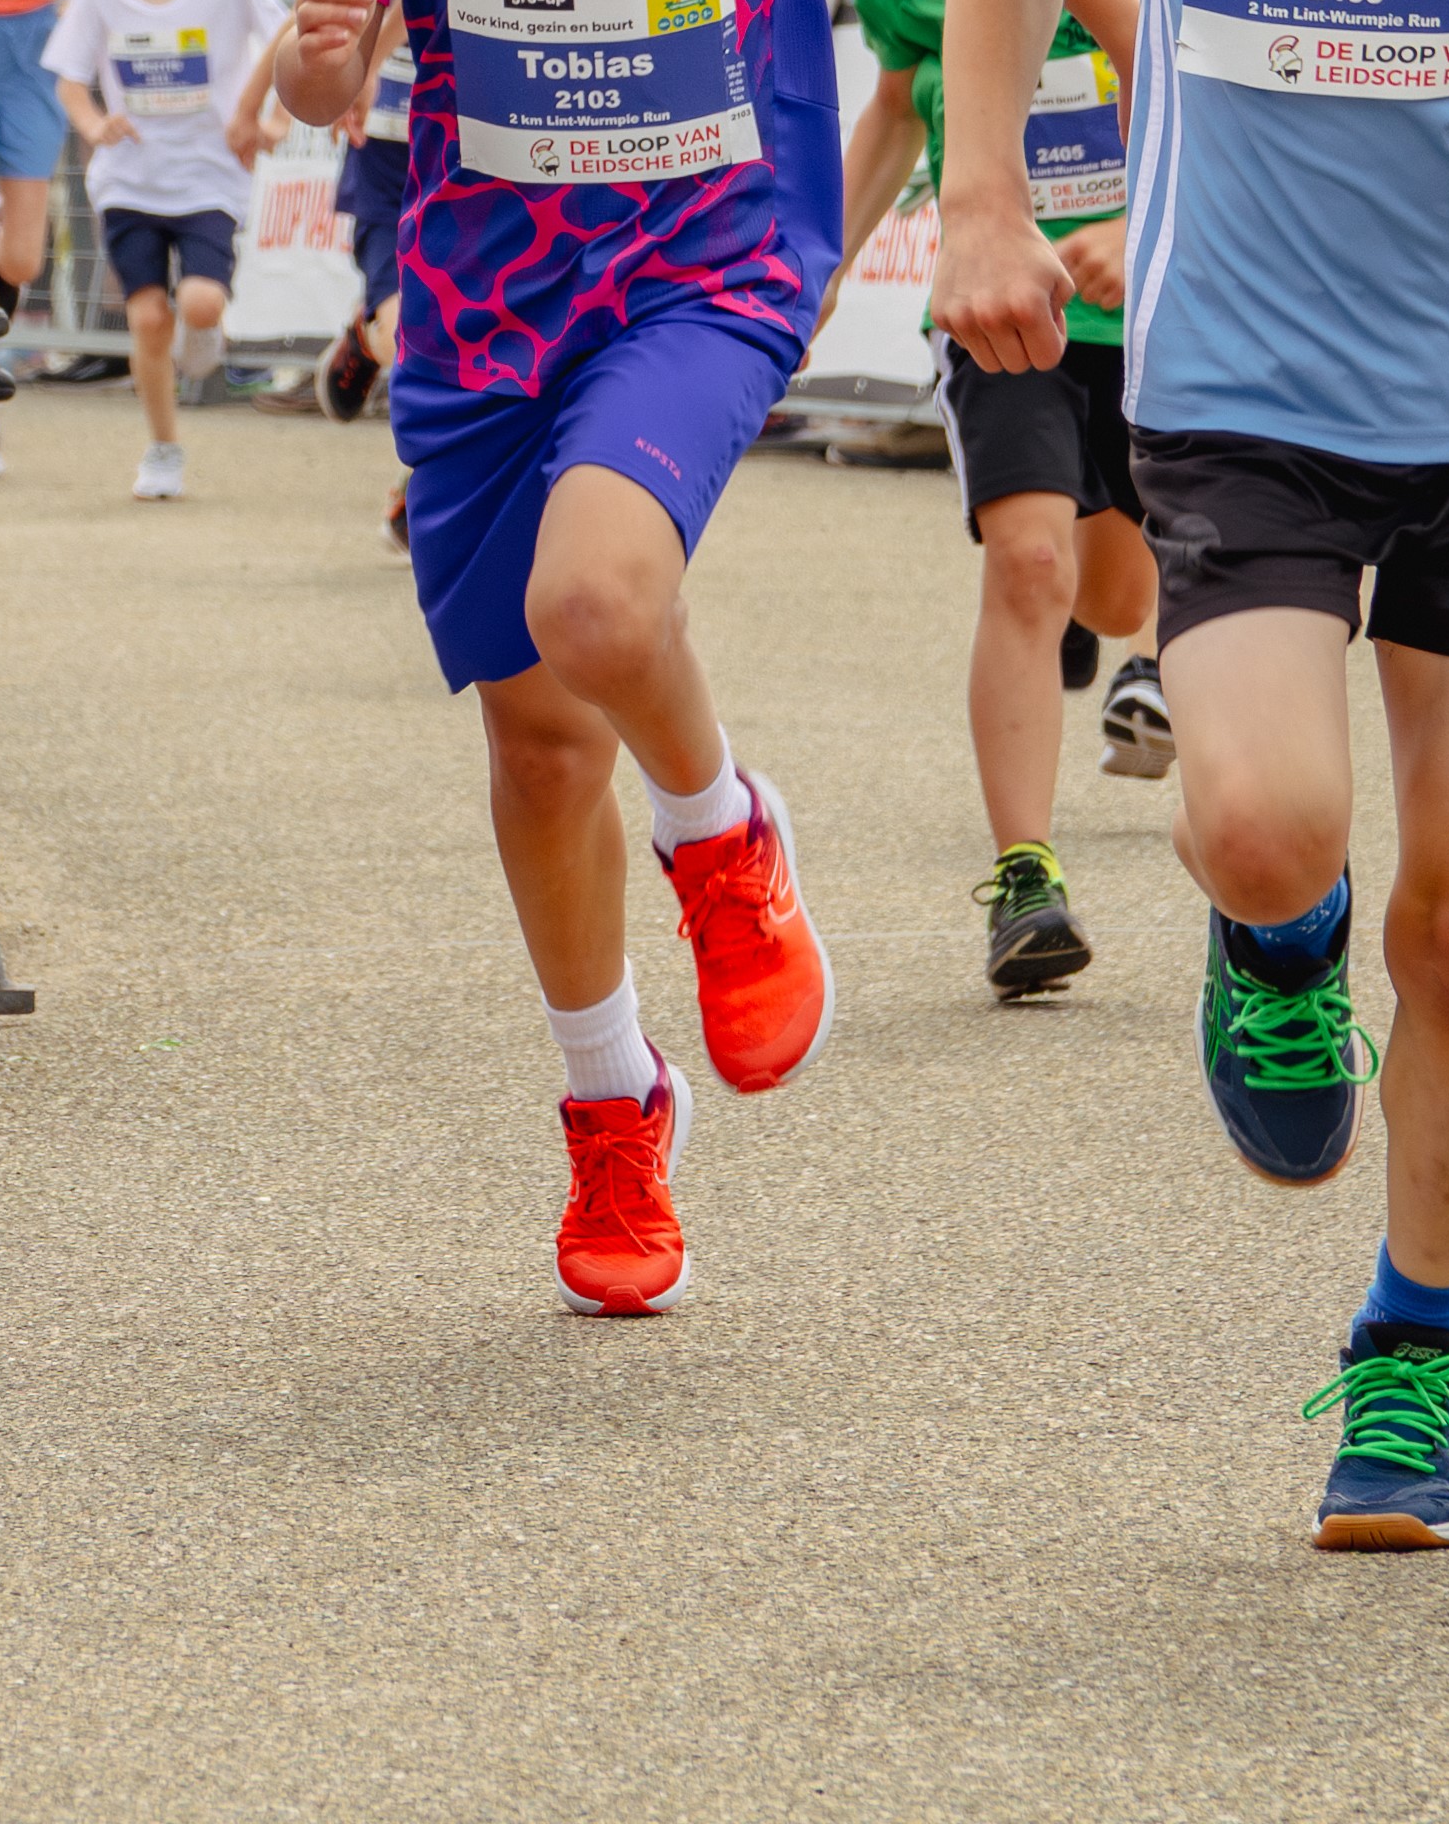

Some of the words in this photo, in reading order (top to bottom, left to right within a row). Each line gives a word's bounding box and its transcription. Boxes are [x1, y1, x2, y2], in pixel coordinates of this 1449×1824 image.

[457, 10, 487, 25] Voor
[490, 15, 523, 33] kind,
[527, 20, 566, 35] gezin
[570, 24, 588, 32] en
[592, 19, 634, 32] buurt
[1248, 1, 1259, 15] 2
[1263, 3, 1289, 19] km
[1293, 7, 1404, 29] Lint-Wurmpie
[1408, 13, 1441, 28] Run
[1316, 40, 1354, 60] DE
[1361, 43, 1436, 64] LOOP
[517, 50, 654, 80] Tobias
[1314, 65, 1437, 87] LEIDSCHE
[555, 90, 621, 109] 2103
[509, 114, 517, 124] 2
[521, 114, 543, 125] km
[547, 114, 640, 127] Lint-Wurmpie
[643, 111, 671, 122] Run
[731, 108, 751, 121] 2103
[570, 140, 600, 156] DE
[607, 136, 670, 155] LOOP
[675, 124, 720, 147] VAN
[570, 157, 674, 174] LEIDSCHE
[680, 144, 722, 166] RIJN
[1051, 184, 1073, 198] DE
[1078, 178, 1123, 194] LOOP
[634, 436, 681, 481] KIPSTA
